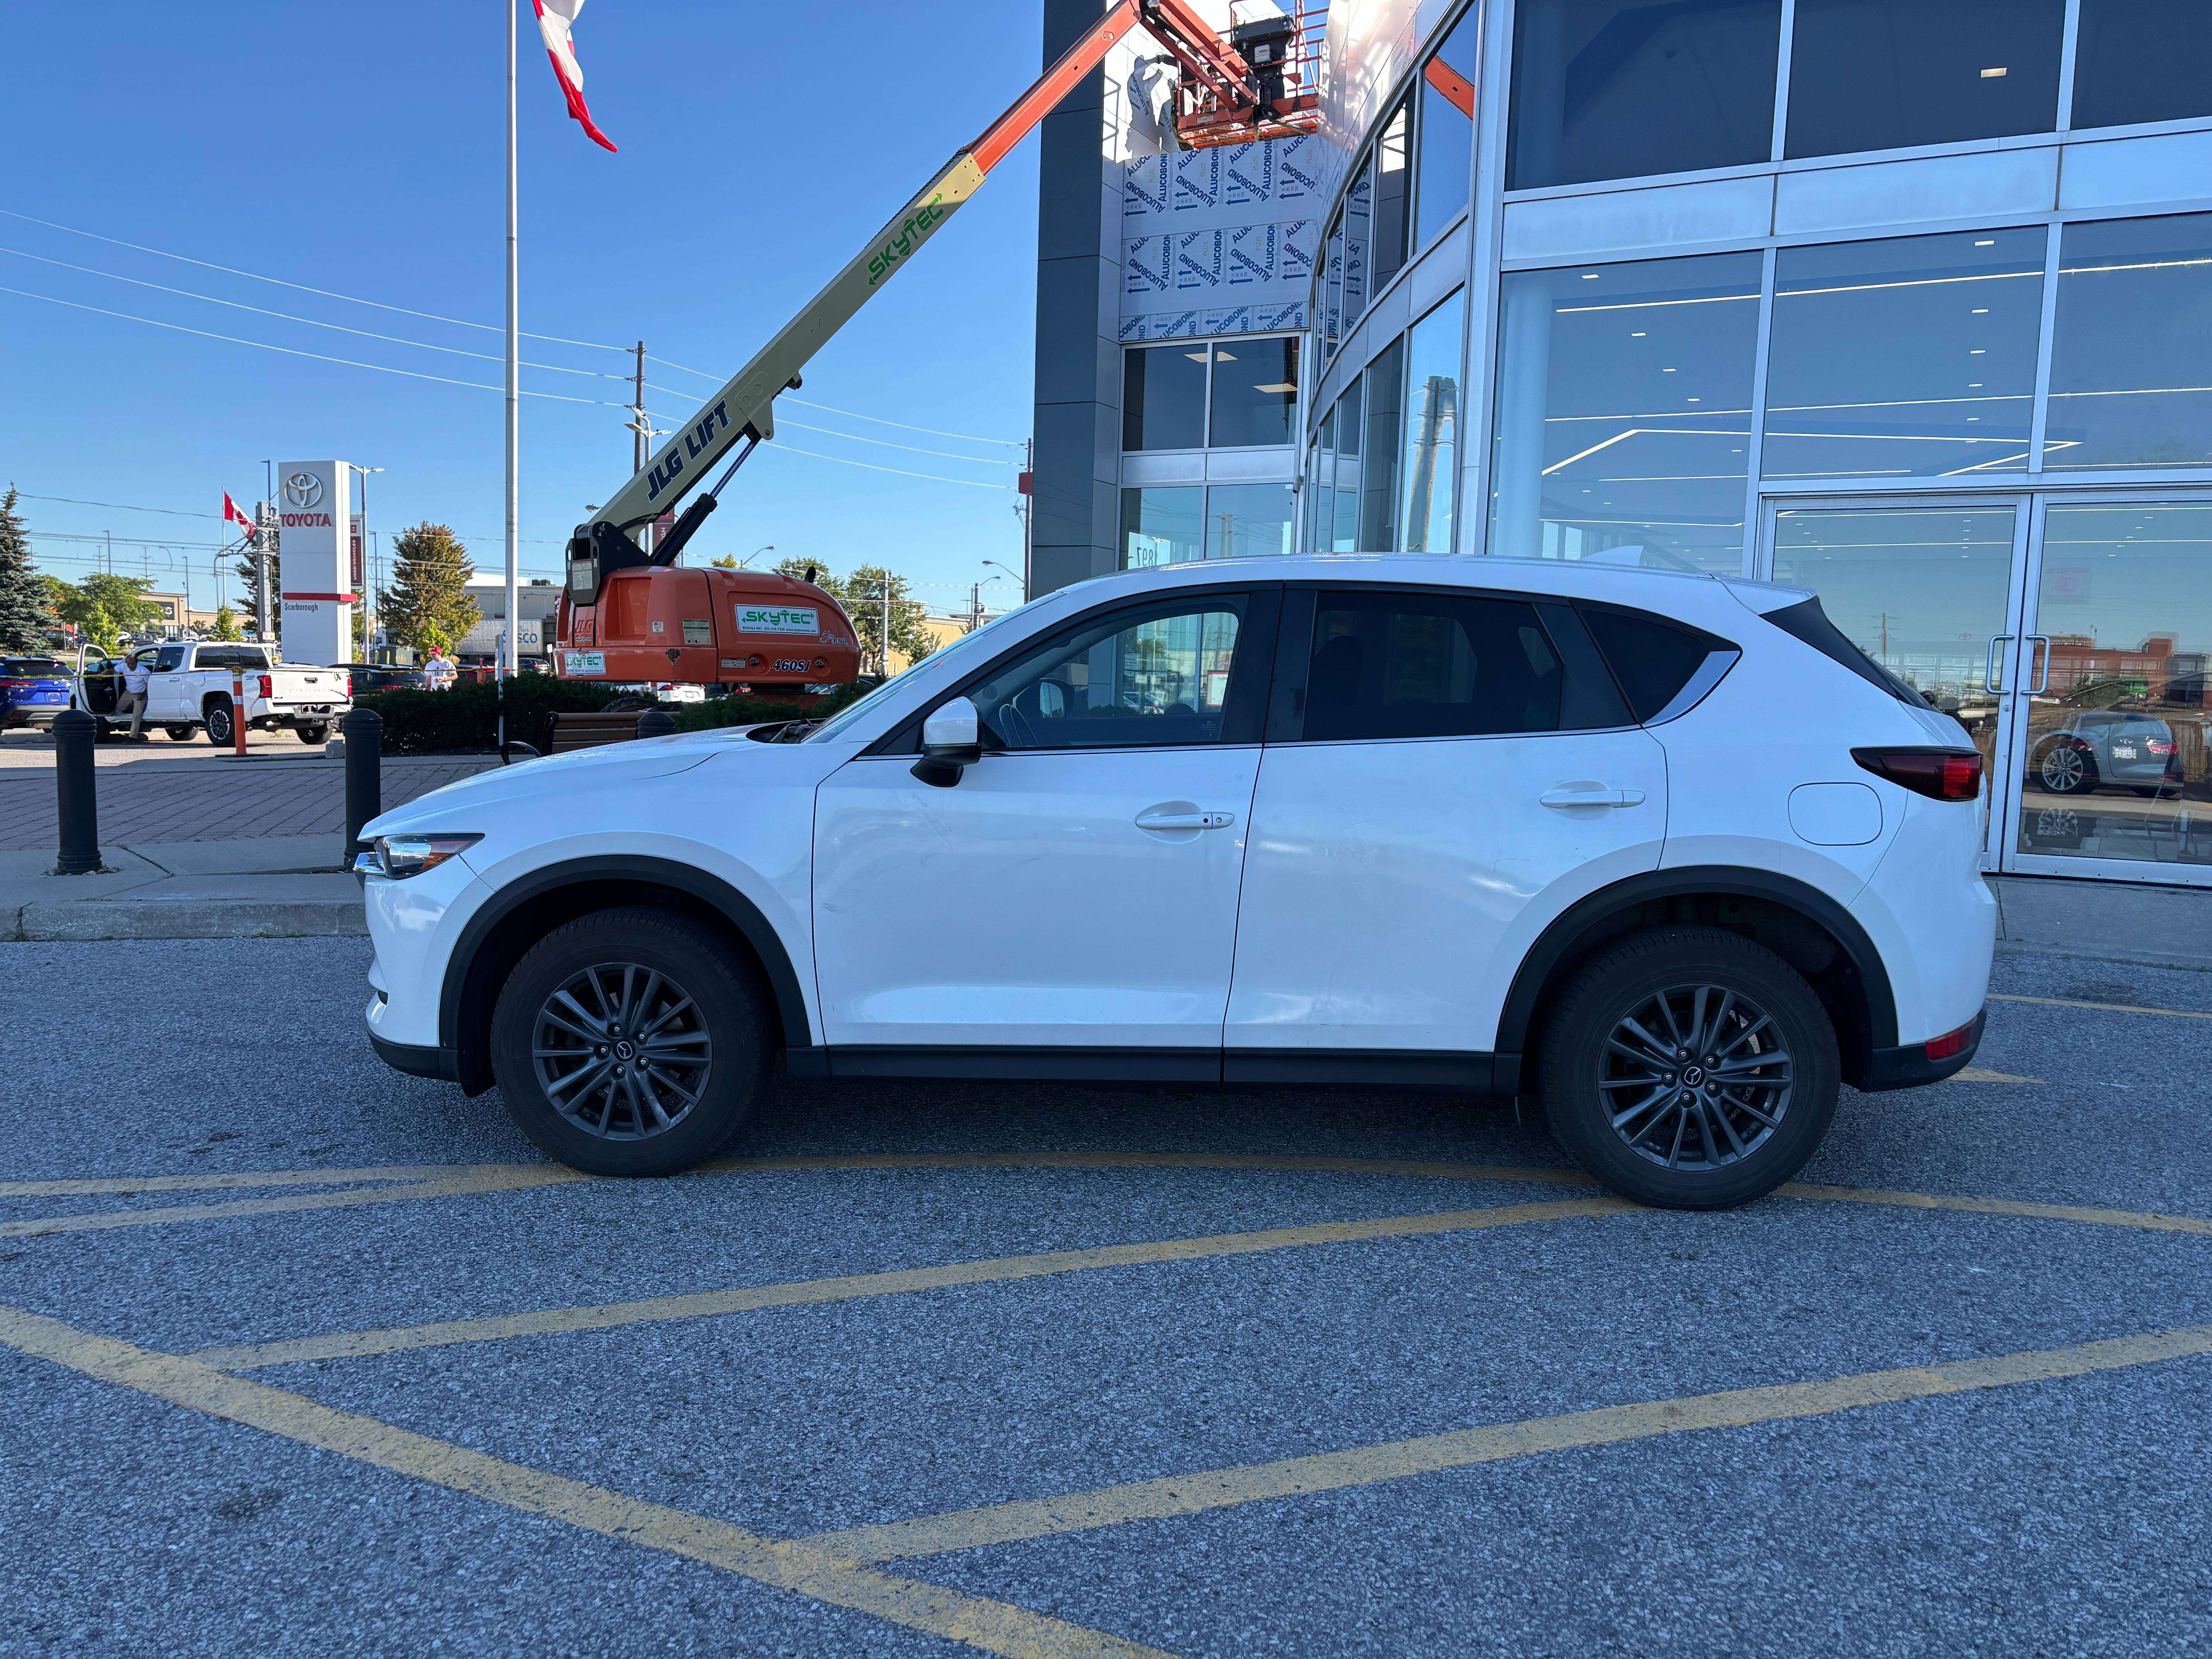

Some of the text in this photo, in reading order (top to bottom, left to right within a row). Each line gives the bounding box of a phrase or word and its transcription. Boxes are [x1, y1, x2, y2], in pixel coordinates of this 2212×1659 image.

[1176, 175, 1217, 208] ALUCOBOND
[1228, 169, 1270, 202] ALUCOBOND
[1281, 162, 1315, 192] UCOBOND
[1126, 181, 1166, 213] ALUCOBOND
[868, 193, 944, 285] SKYTEC
[1129, 258, 1169, 291] ALUCOBOND
[1179, 254, 1220, 287] ALUCOBOND
[1230, 248, 1273, 282] ALUCOBOND
[646, 399, 728, 503] JLG LIFT
[279, 513, 332, 527] TOYOTA
[285, 603, 318, 612] Scarborough
[743, 611, 813, 625] SKYTEC
[772, 659, 811, 673] 460SJ
